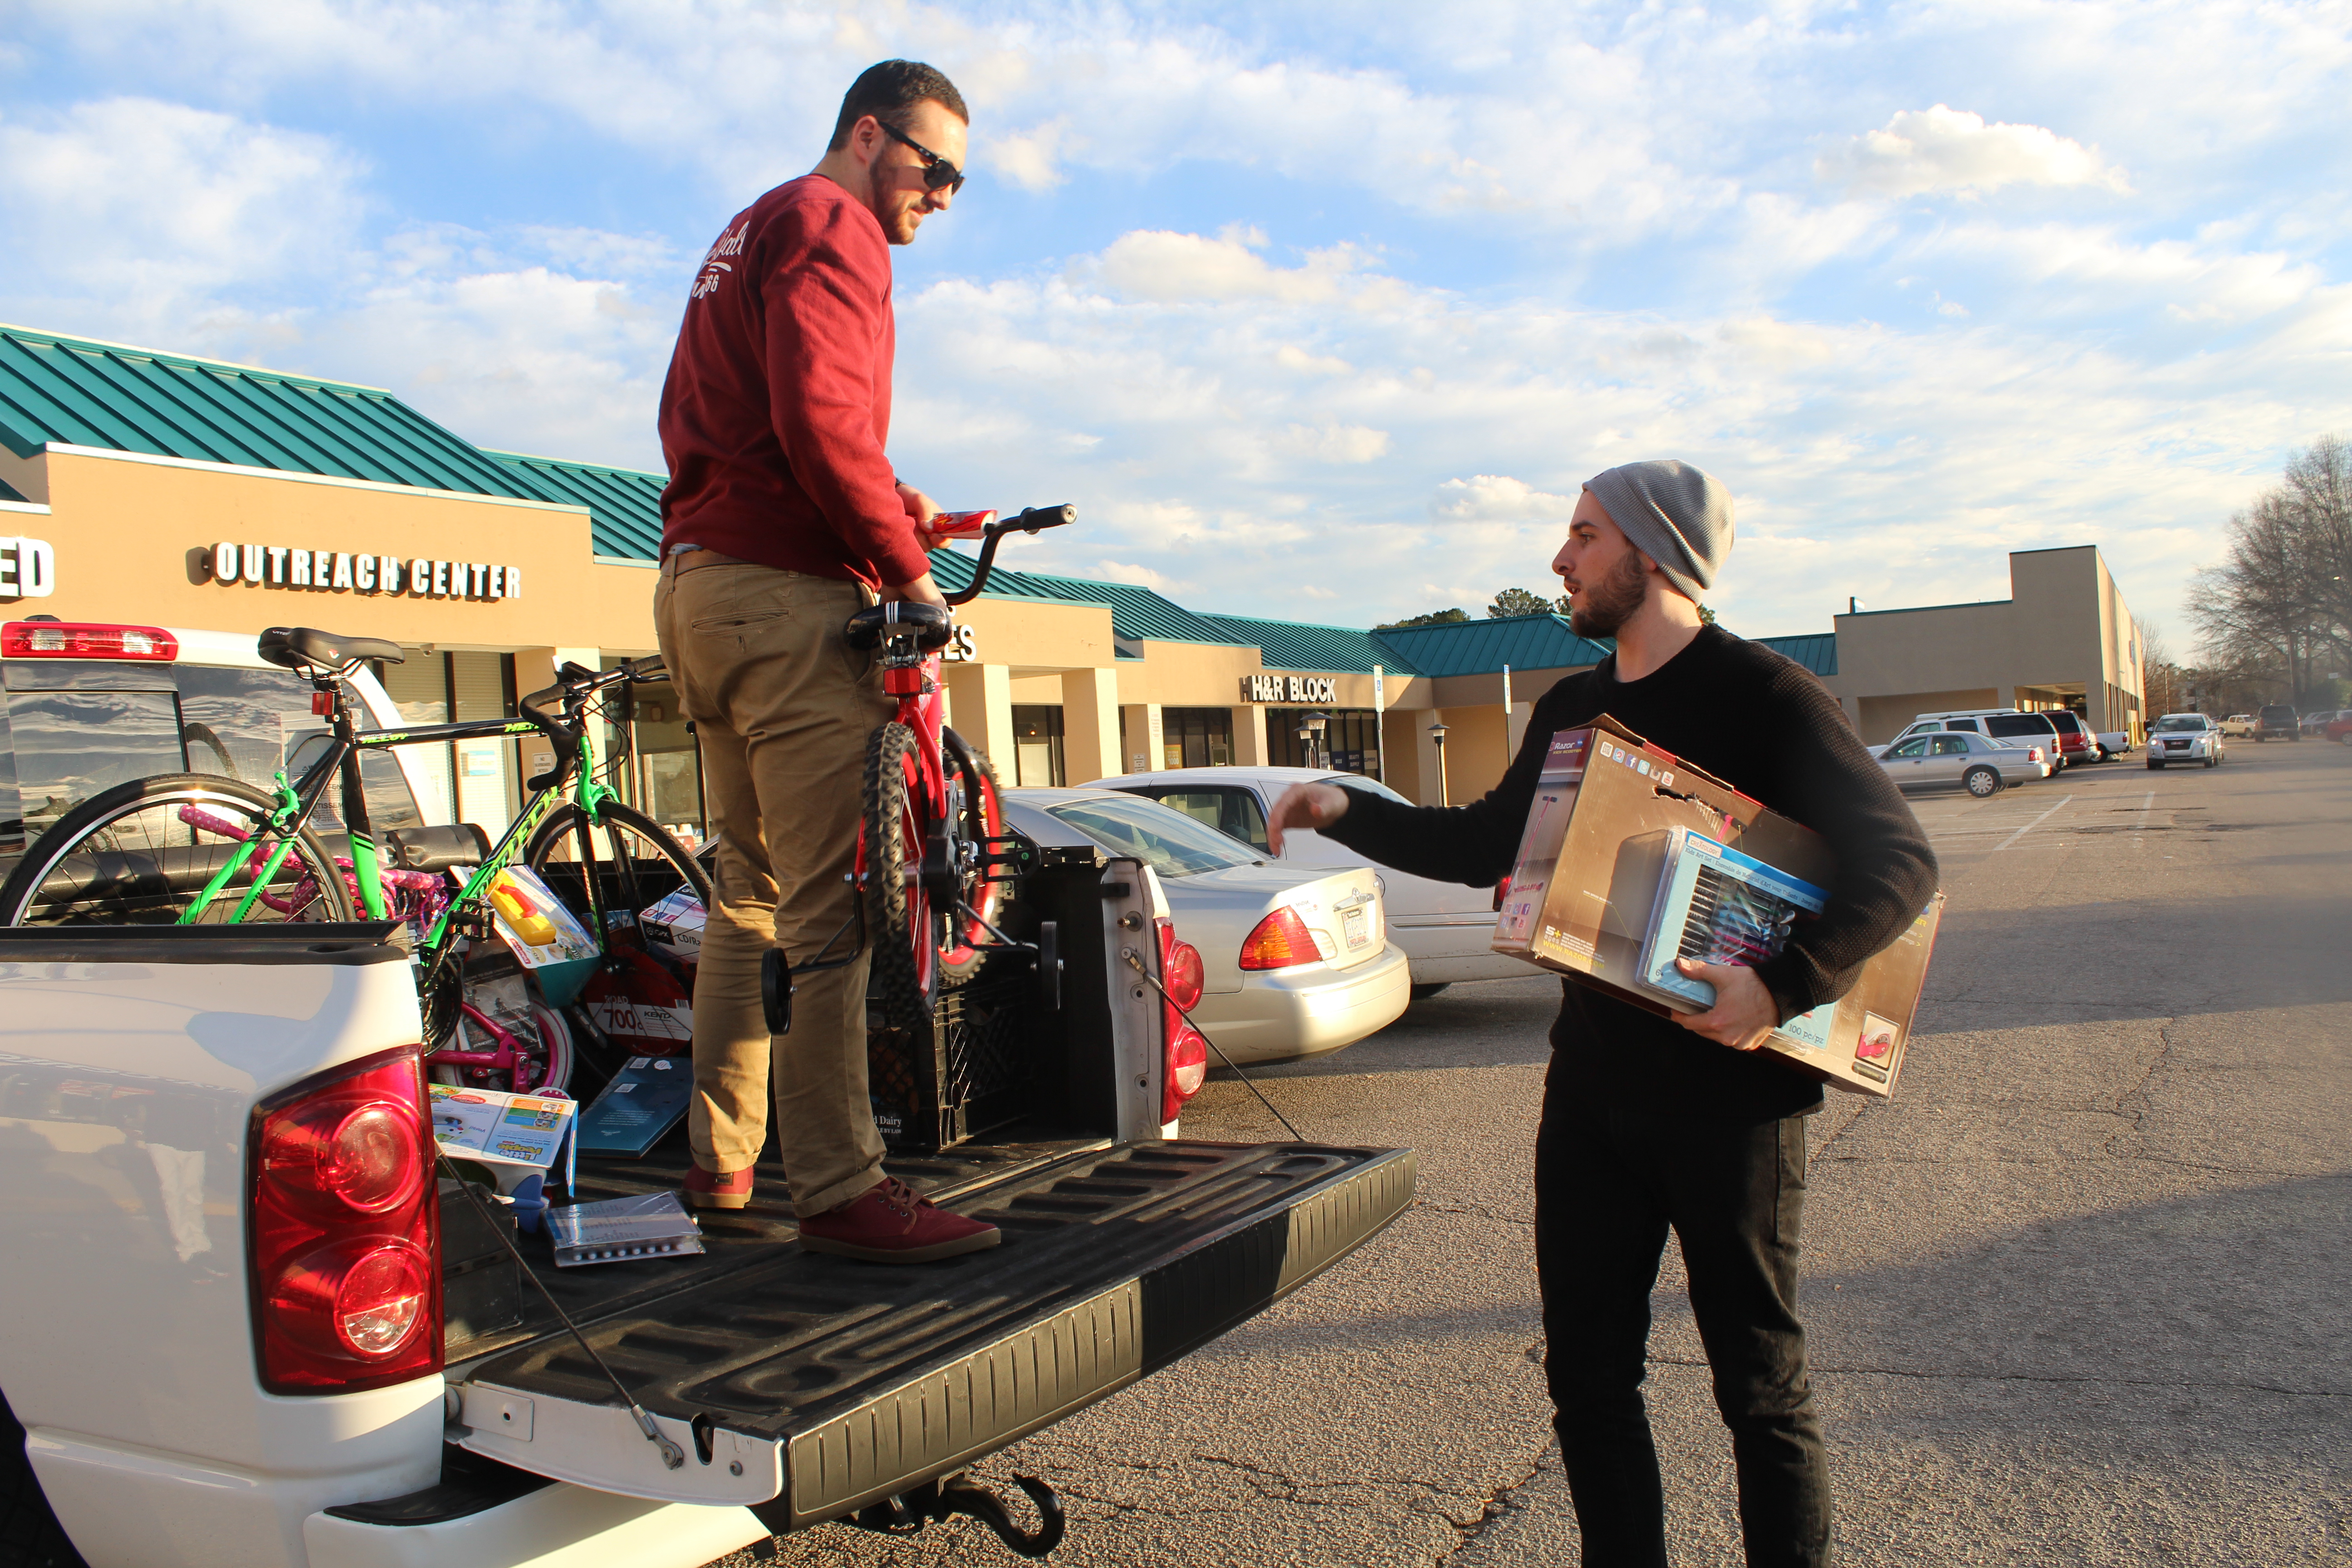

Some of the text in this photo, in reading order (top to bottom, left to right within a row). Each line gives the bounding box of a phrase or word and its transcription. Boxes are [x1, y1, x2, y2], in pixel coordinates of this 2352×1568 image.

[216, 542, 520, 598] OUTREACH CENTER
[1251, 675, 1337, 703] H&R BLOCK
[362, 733, 409, 744] ALLOY
[1690, 839, 1718, 855] CREATOLOGY
[1684, 847, 1695, 856] Kids
[1715, 860, 1735, 873] Ensemble
[1772, 885, 1782, 893] pour
[1544, 935, 1560, 944] ages
[1543, 940, 1605, 969] WWW.RAZOR.COM
[604, 995, 629, 1004] ROAD
[1788, 1024, 1824, 1044] 100 pc/pz
[879, 1116, 902, 1127] Dairy
[496, 1143, 543, 1155] People
[499, 1150, 537, 1161] Little
